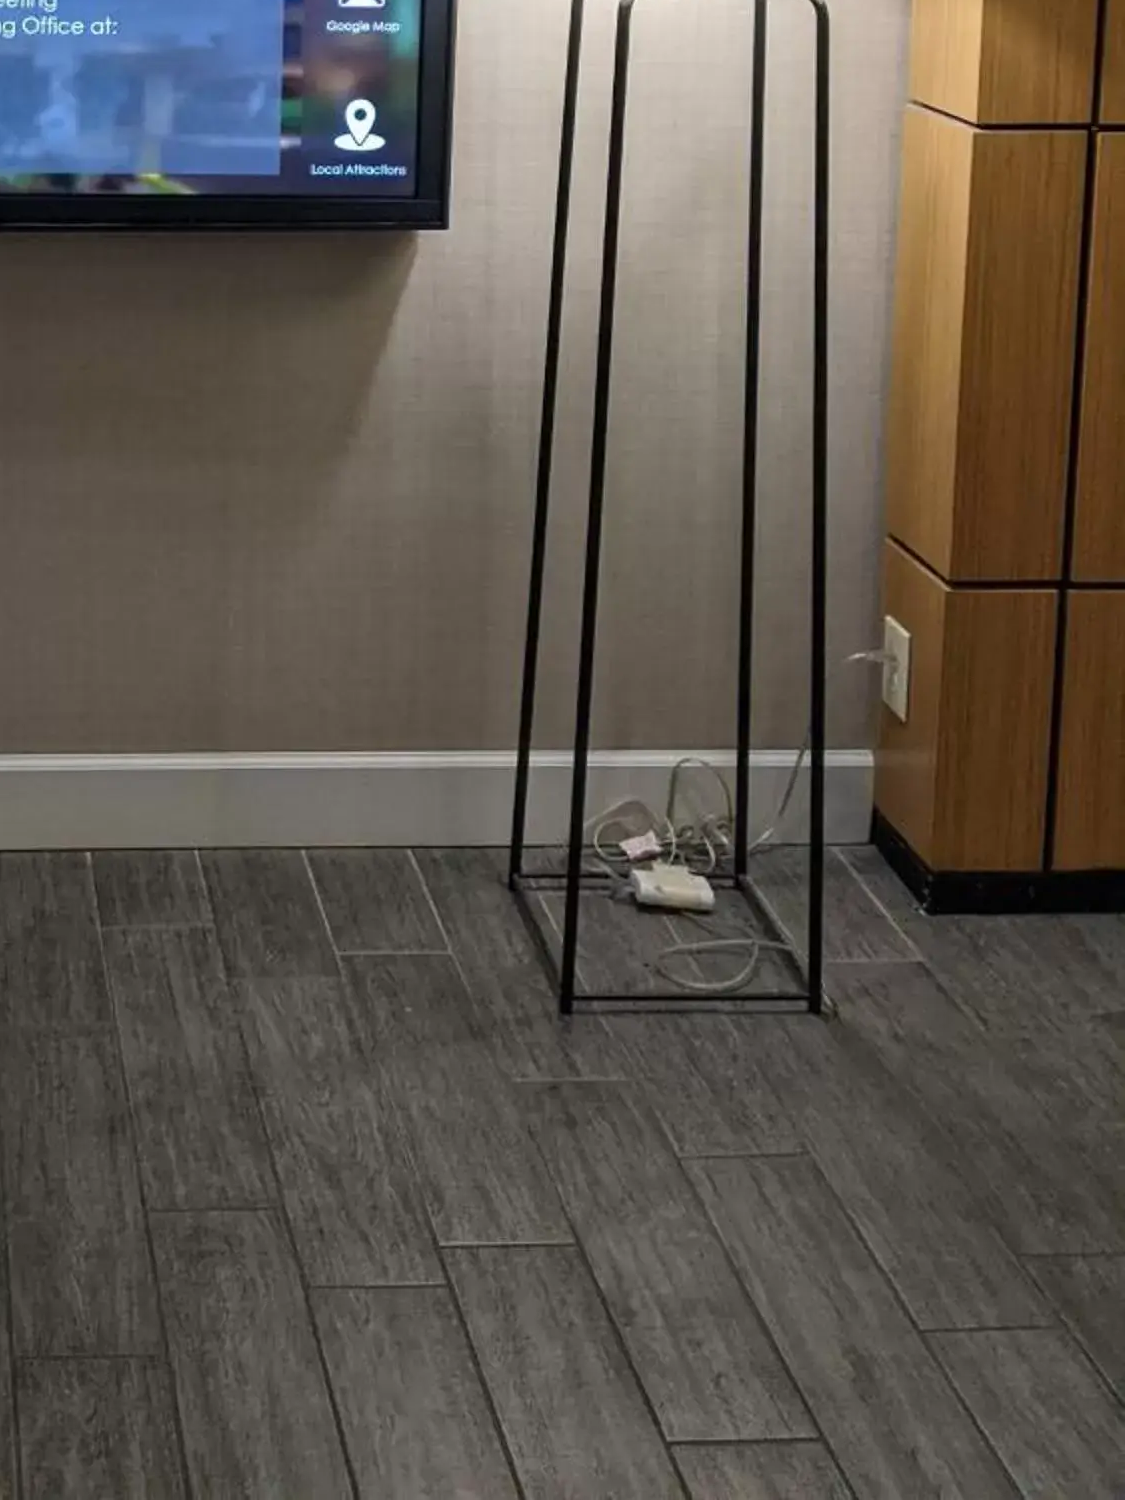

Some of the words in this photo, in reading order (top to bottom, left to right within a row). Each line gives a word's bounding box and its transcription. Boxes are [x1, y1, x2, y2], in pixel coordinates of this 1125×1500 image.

[21, 15, 85, 36] Office
[90, 17, 119, 36] at:
[326, 19, 370, 33] Google
[373, 20, 400, 33] Map
[310, 164, 343, 175] Local
[345, 164, 407, 176] Attractions
